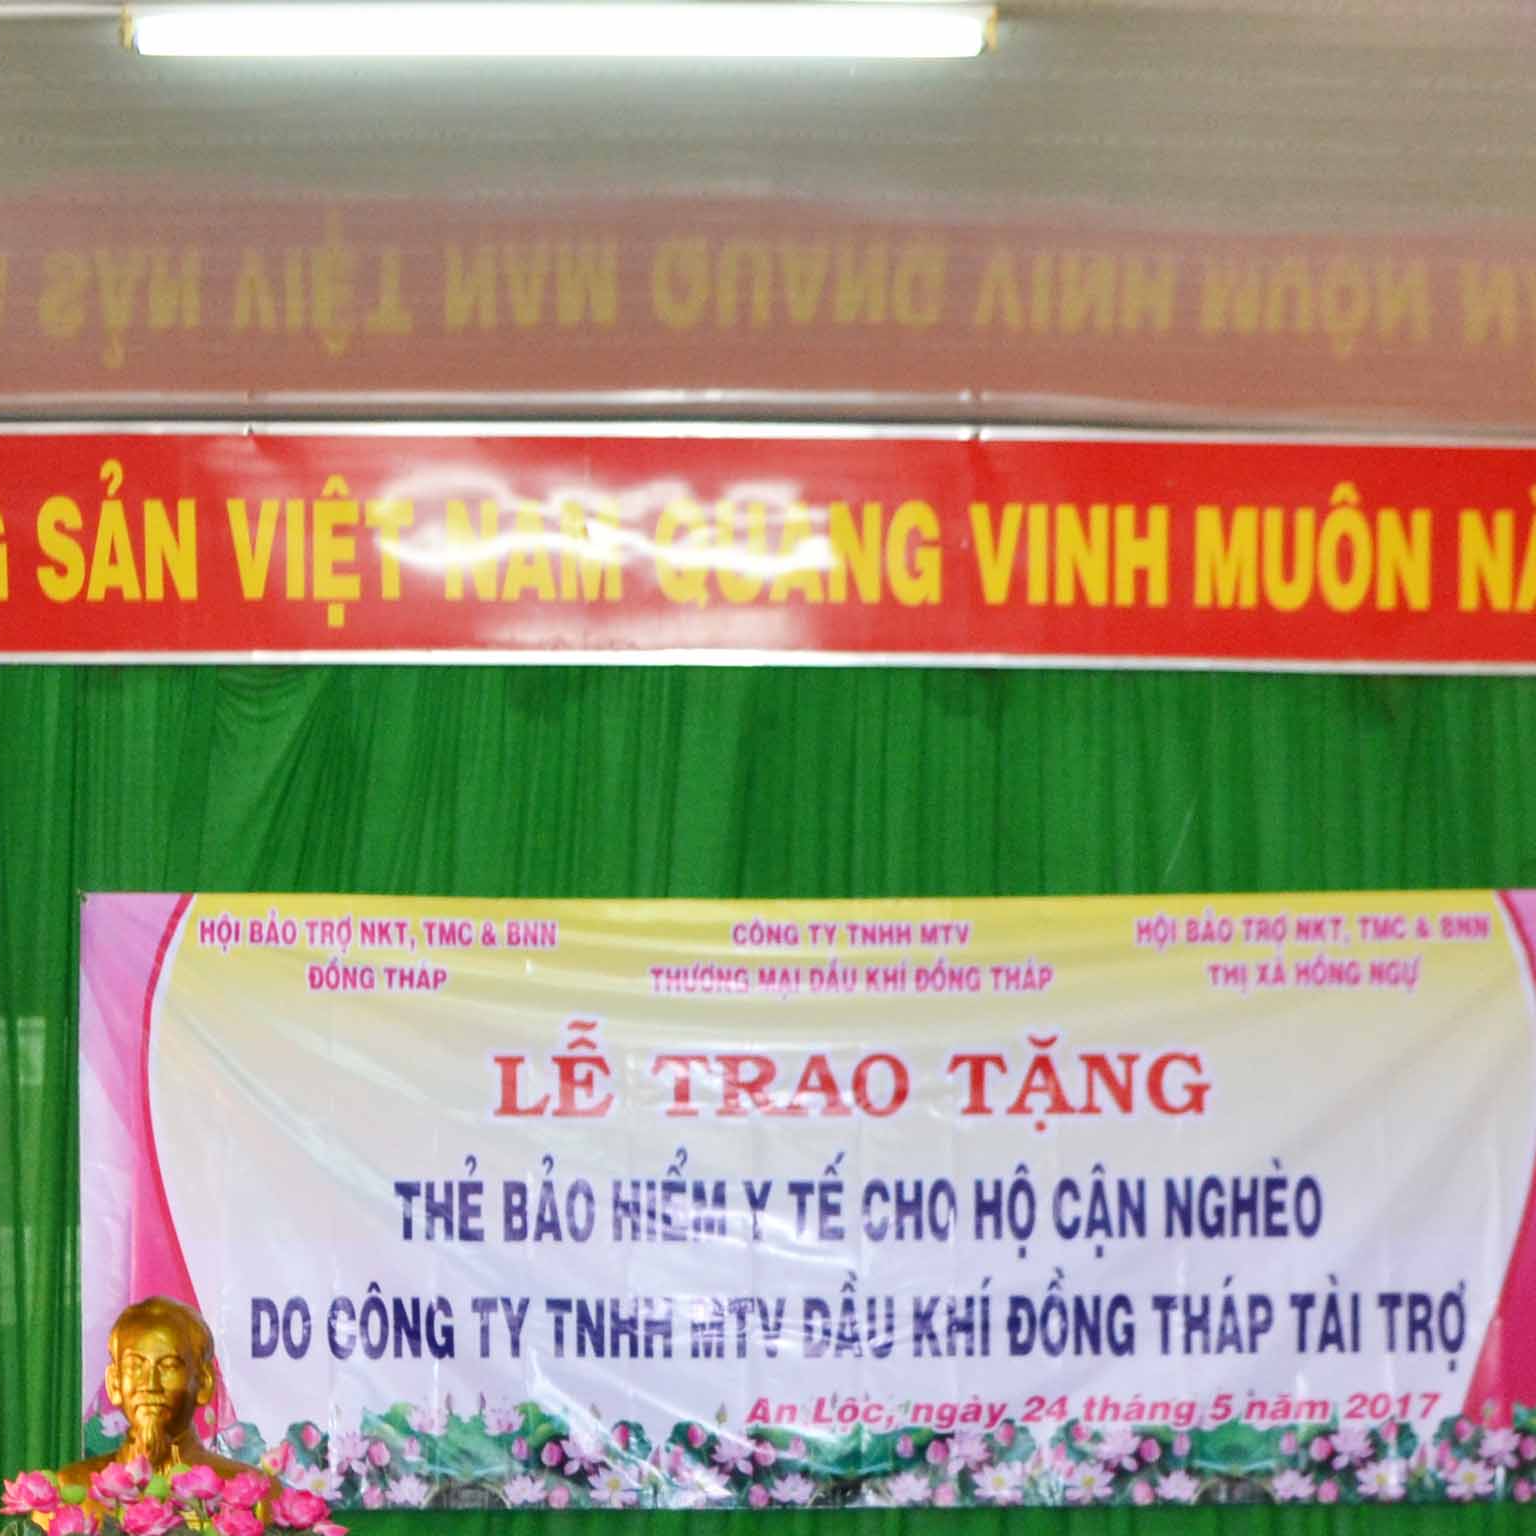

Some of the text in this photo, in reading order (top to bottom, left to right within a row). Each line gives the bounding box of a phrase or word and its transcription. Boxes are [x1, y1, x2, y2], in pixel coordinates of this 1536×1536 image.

[37, 460, 197, 602] SẢN
[227, 475, 411, 628] VIỆT
[444, 498, 620, 602] NAM
[658, 498, 941, 610] QUANG
[969, 503, 1167, 606] VINH
[1194, 482, 1431, 611] MUÔN
[199, 909, 557, 953] HỘI BẢO TRỢ NKT, TMC & BNN
[732, 917, 971, 946] CÔNG TY TNHH MTV
[1136, 914, 1177, 951] HỘI
[1242, 914, 1288, 951] TRỢ
[1358, 916, 1406, 940] TMC
[308, 957, 448, 990] ĐỒNG THÁP
[492, 1020, 1213, 1133] LỄ TRAO TẶNG
[394, 1147, 1323, 1258] THẺ BẢO HIỂM Y TẾ CHO HỘ CẬN NGHÈO
[251, 1269, 1467, 1370] DO CÔNG TY TNHH MTV DẦU KHÍ ĐỒNG THÁP TÀI TRỢ
[746, 1396, 798, 1424] An
[910, 1395, 1006, 1428] ngày
[1022, 1396, 1069, 1422] 24
[1082, 1391, 1198, 1427] tháng
[1210, 1394, 1233, 1421] 5
[1245, 1391, 1333, 1422] năm
[1346, 1392, 1440, 1420] 2017
